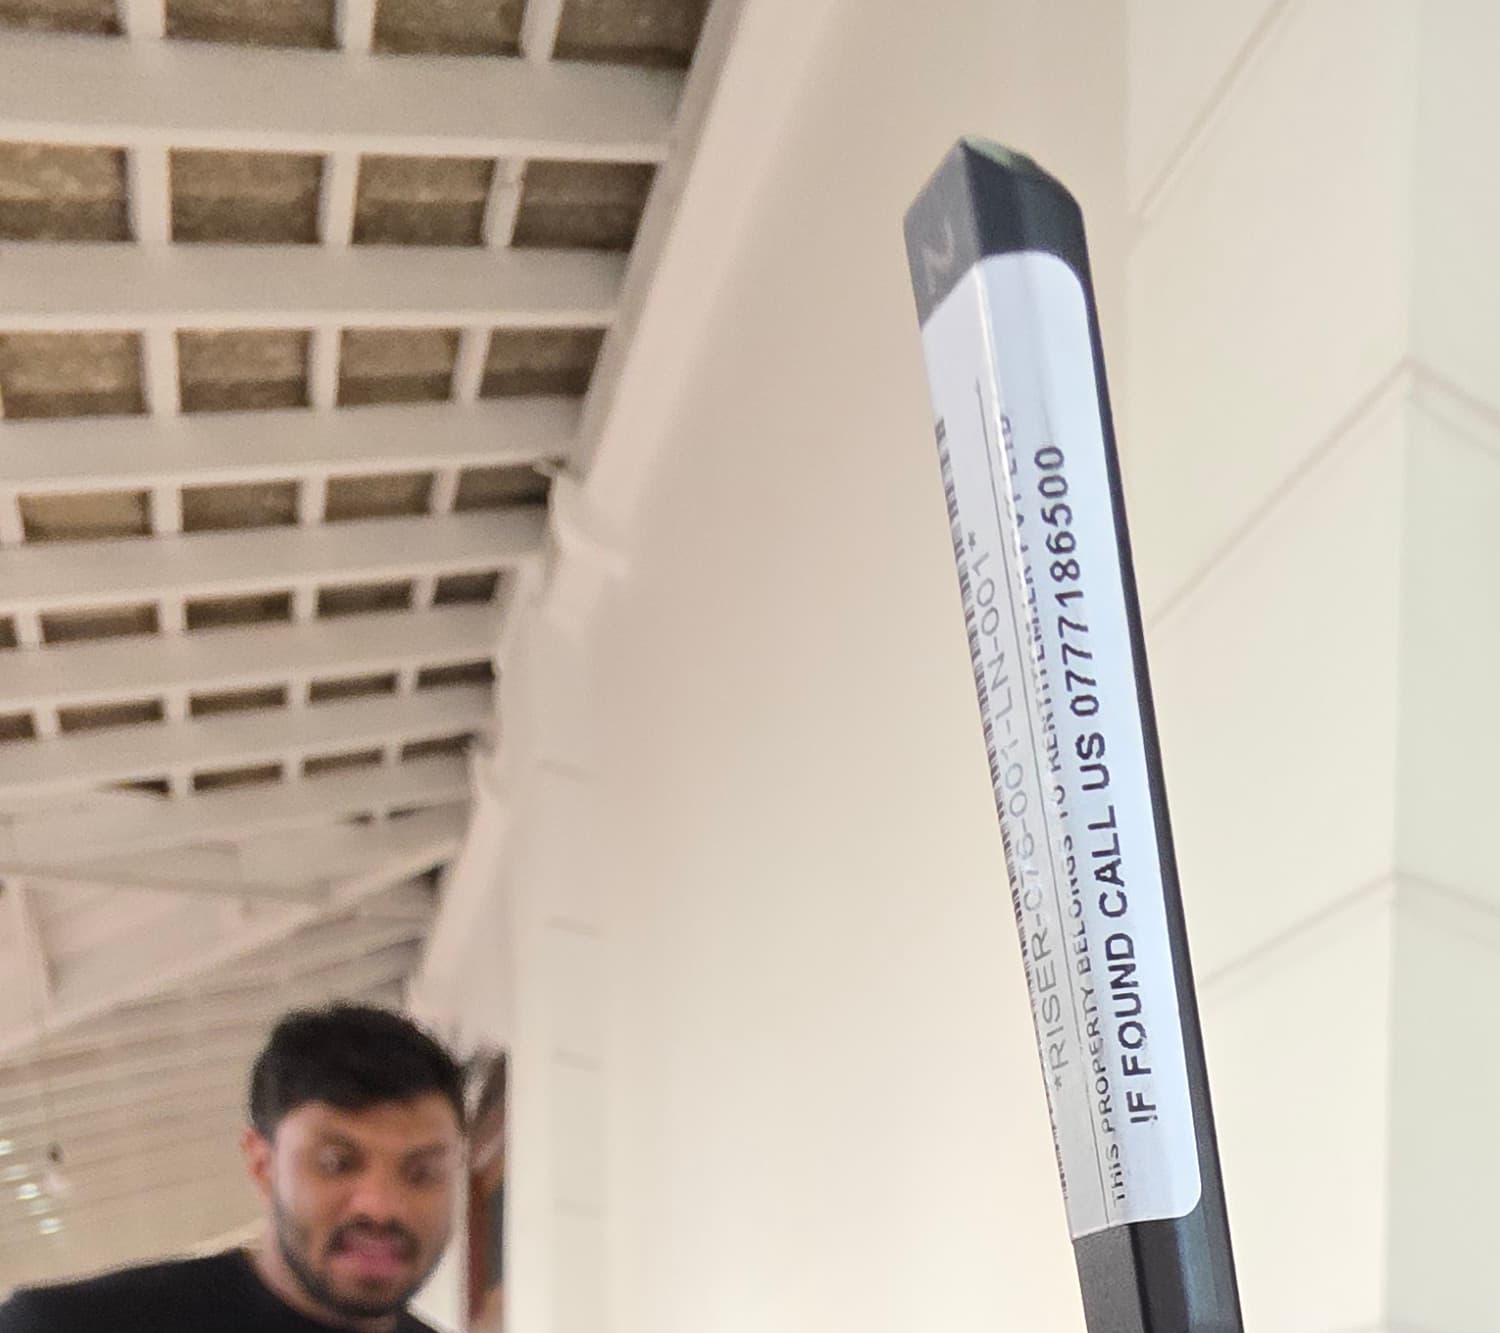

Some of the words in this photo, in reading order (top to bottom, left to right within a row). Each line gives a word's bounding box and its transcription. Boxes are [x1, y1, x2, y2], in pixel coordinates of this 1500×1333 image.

[1034, 445, 1100, 718] 0777186500
[1074, 731, 1111, 791] US
[1087, 804, 1128, 919] CALL
[1080, 989, 1117, 1133] PROPERTY
[1105, 931, 1152, 1077] FOUND
[1128, 1089, 1158, 1126] IF
